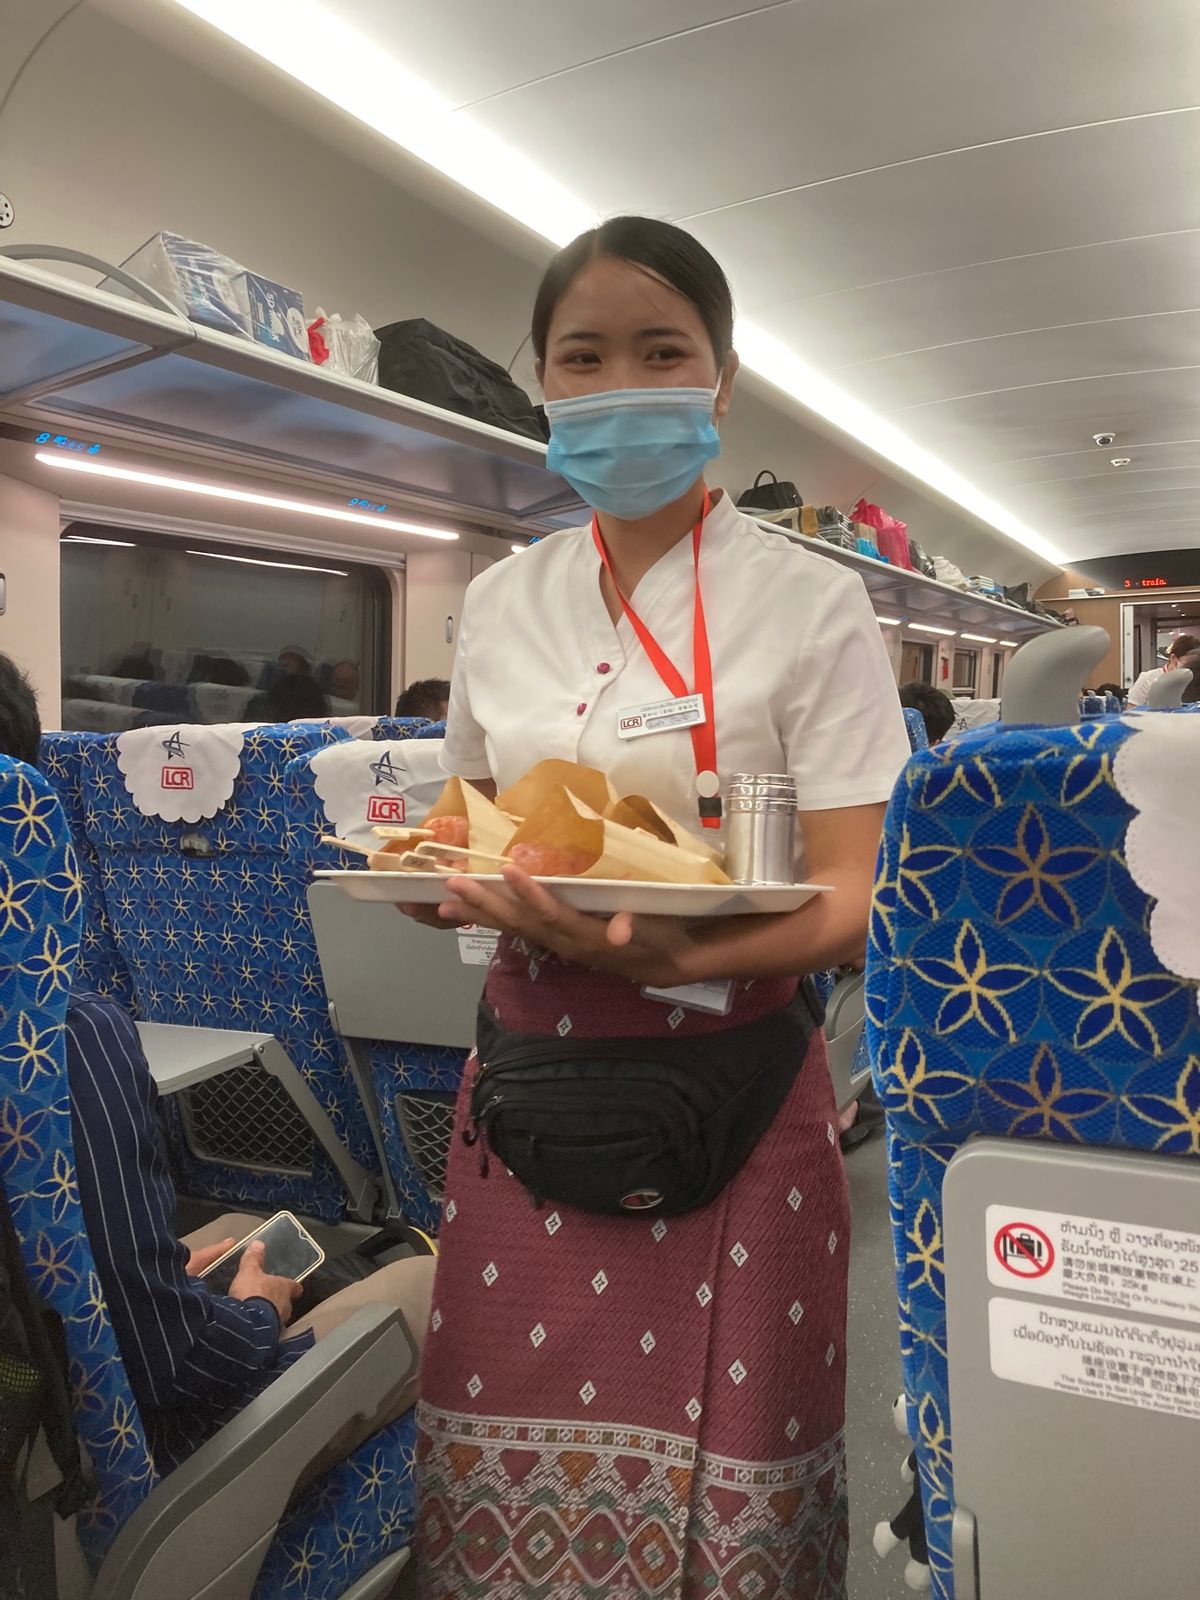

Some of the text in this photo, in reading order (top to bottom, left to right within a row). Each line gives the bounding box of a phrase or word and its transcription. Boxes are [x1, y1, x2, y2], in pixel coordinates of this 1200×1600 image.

[35, 432, 51, 443] 8
[1124, 579, 1131, 588] 3
[622, 717, 640, 728] LCR
[165, 770, 190, 786] LCR
[371, 800, 401, 819] LCR
[1180, 1258, 1199, 1274] 25
